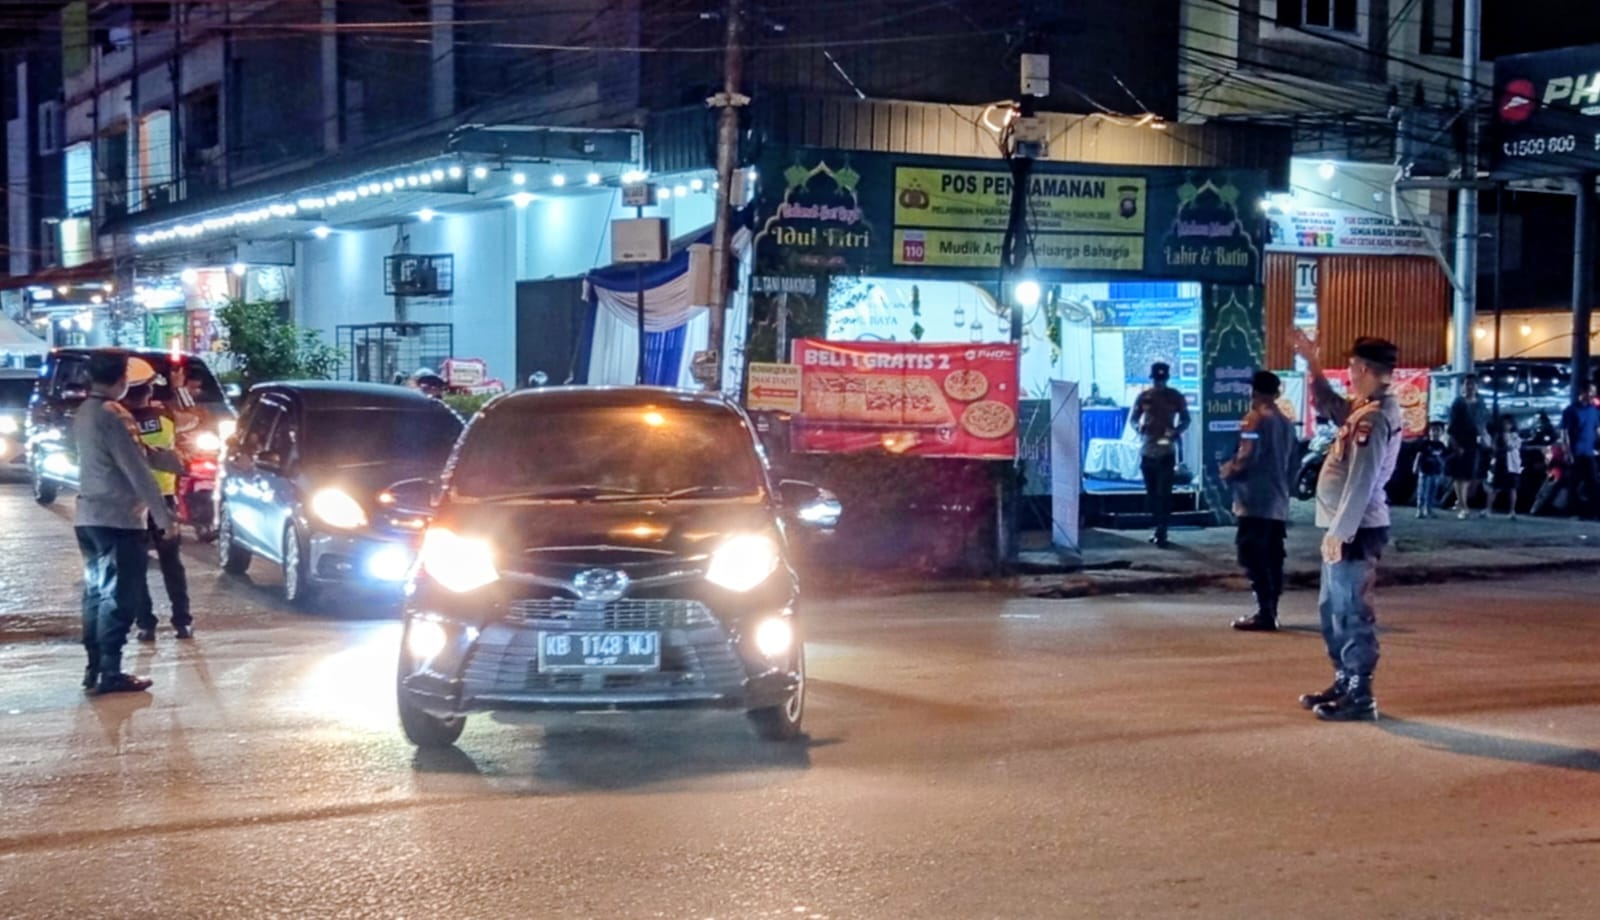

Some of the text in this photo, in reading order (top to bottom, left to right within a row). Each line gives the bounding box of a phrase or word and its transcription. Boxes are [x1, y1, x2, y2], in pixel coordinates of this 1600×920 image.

[941, 174, 1106, 199] POS PENAMANAN
[904, 245, 924, 258] 110
[939, 242, 978, 255] Mudik
[1036, 244, 1081, 260] eluarga
[1083, 245, 1130, 261] Bahagia
[805, 349, 846, 368] BELI
[863, 351, 936, 370] GRATIS
[938, 354, 950, 370] 2
[545, 635, 654, 657] KB 1148 WJ
